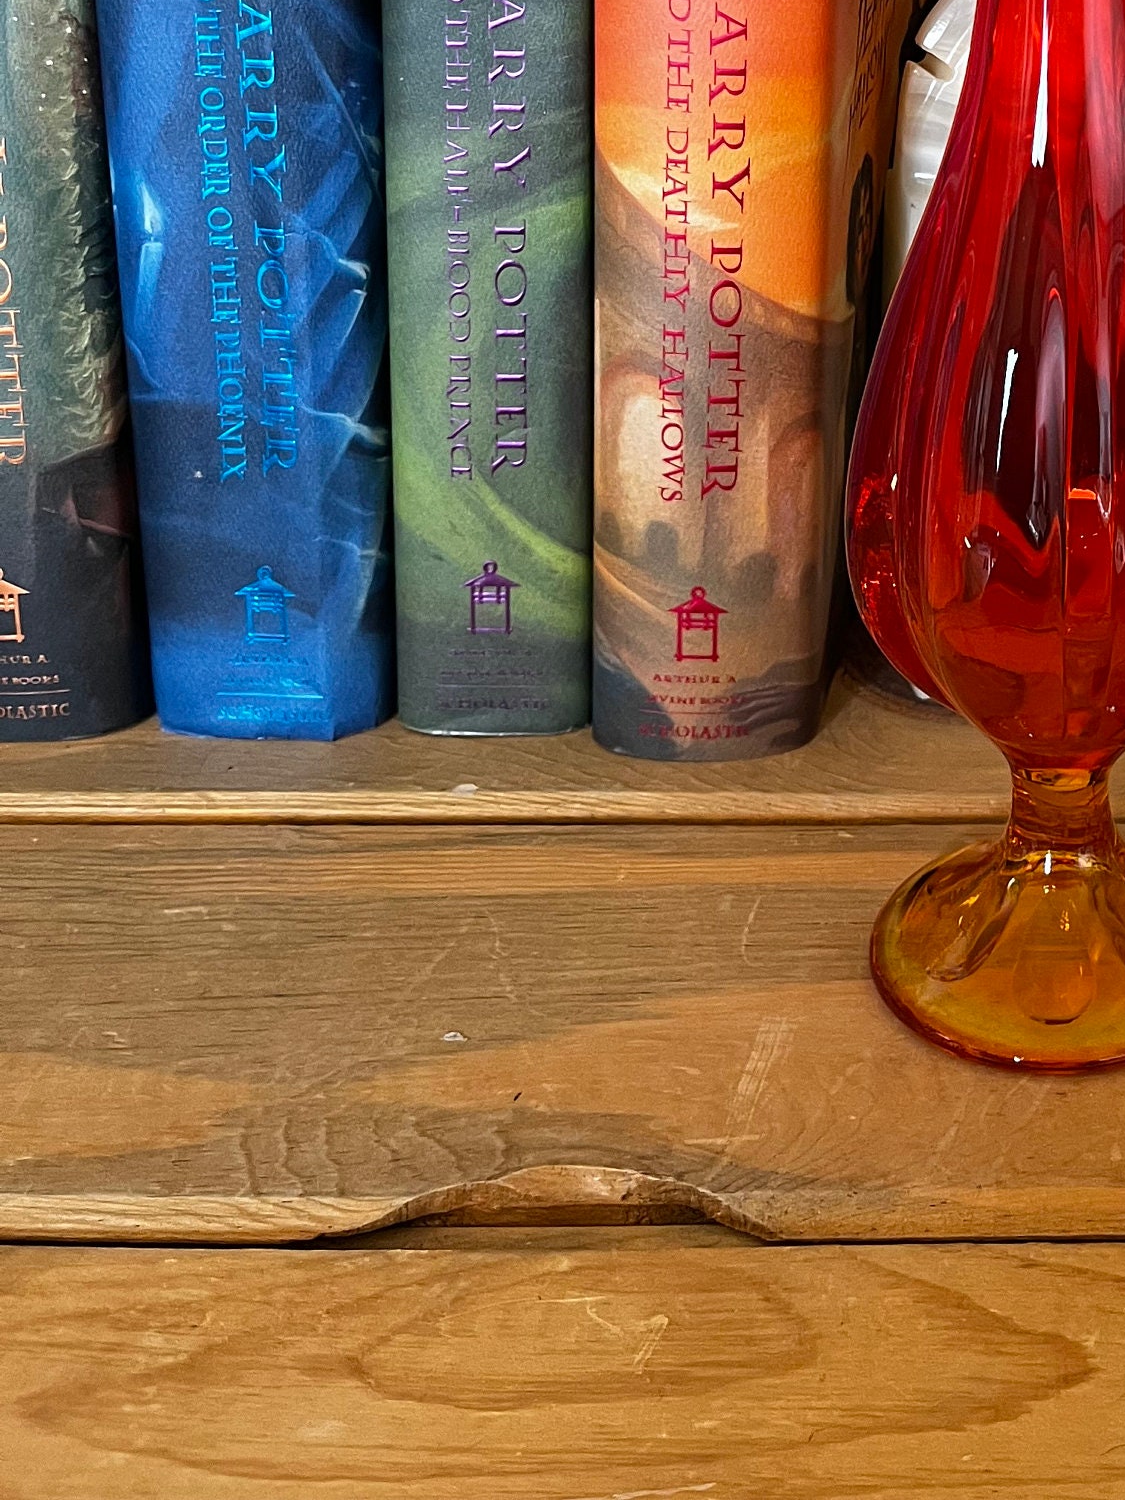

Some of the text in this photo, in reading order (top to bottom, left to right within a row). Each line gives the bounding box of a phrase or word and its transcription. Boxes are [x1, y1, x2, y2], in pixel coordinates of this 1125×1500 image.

[194, 9, 226, 80] THE
[442, 9, 474, 93] THE
[663, 28, 694, 115] THE
[197, 86, 234, 200] ORDER
[206, 206, 240, 250] OF
[660, 126, 693, 313] DEATHLY
[210, 257, 243, 325] THE
[253, 220, 300, 478] POTTER
[491, 219, 529, 478] POTTER
[215, 330, 249, 484] PHOENIX
[444, 354, 473, 482] PRINCE
[658, 325, 690, 503] HALLOWS
[701, 238, 746, 500] POTTER
